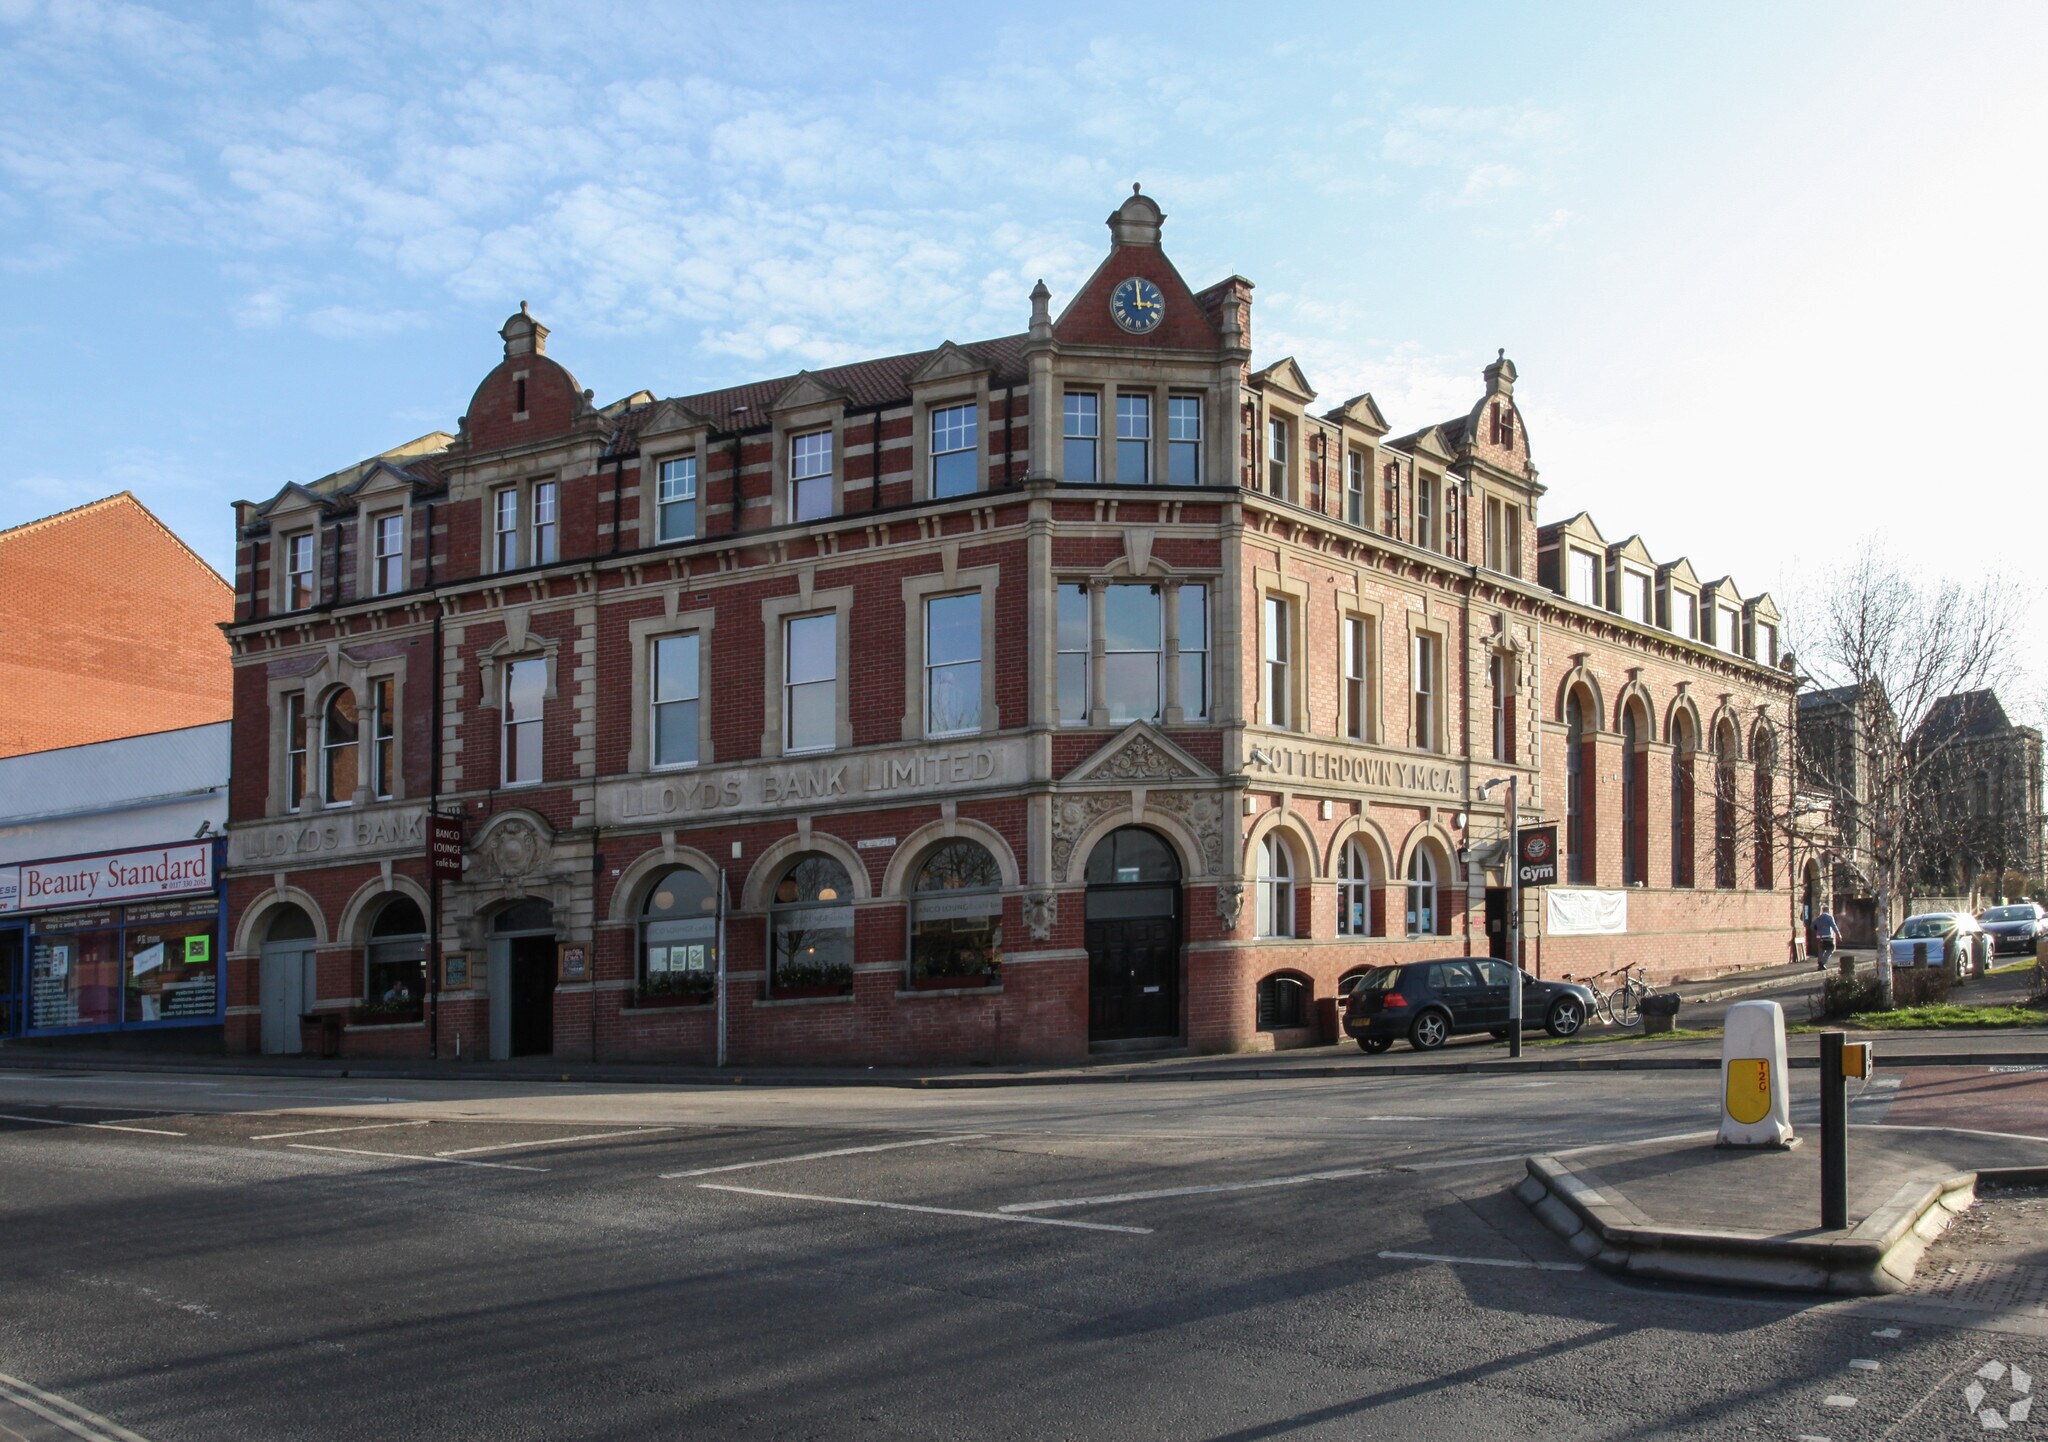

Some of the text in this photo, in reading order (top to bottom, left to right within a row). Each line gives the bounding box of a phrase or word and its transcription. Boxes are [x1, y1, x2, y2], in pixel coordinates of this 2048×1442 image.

[622, 750, 995, 818] LLOYDS BANK LIMITED
[243, 813, 424, 859] LLOYDS BANK
[435, 828, 460, 841] BANCO
[433, 842, 461, 855] LOUNGE
[435, 857, 460, 869] café bar
[27, 848, 207, 898] Beauty Standard
[1520, 866, 1554, 882] Gym
